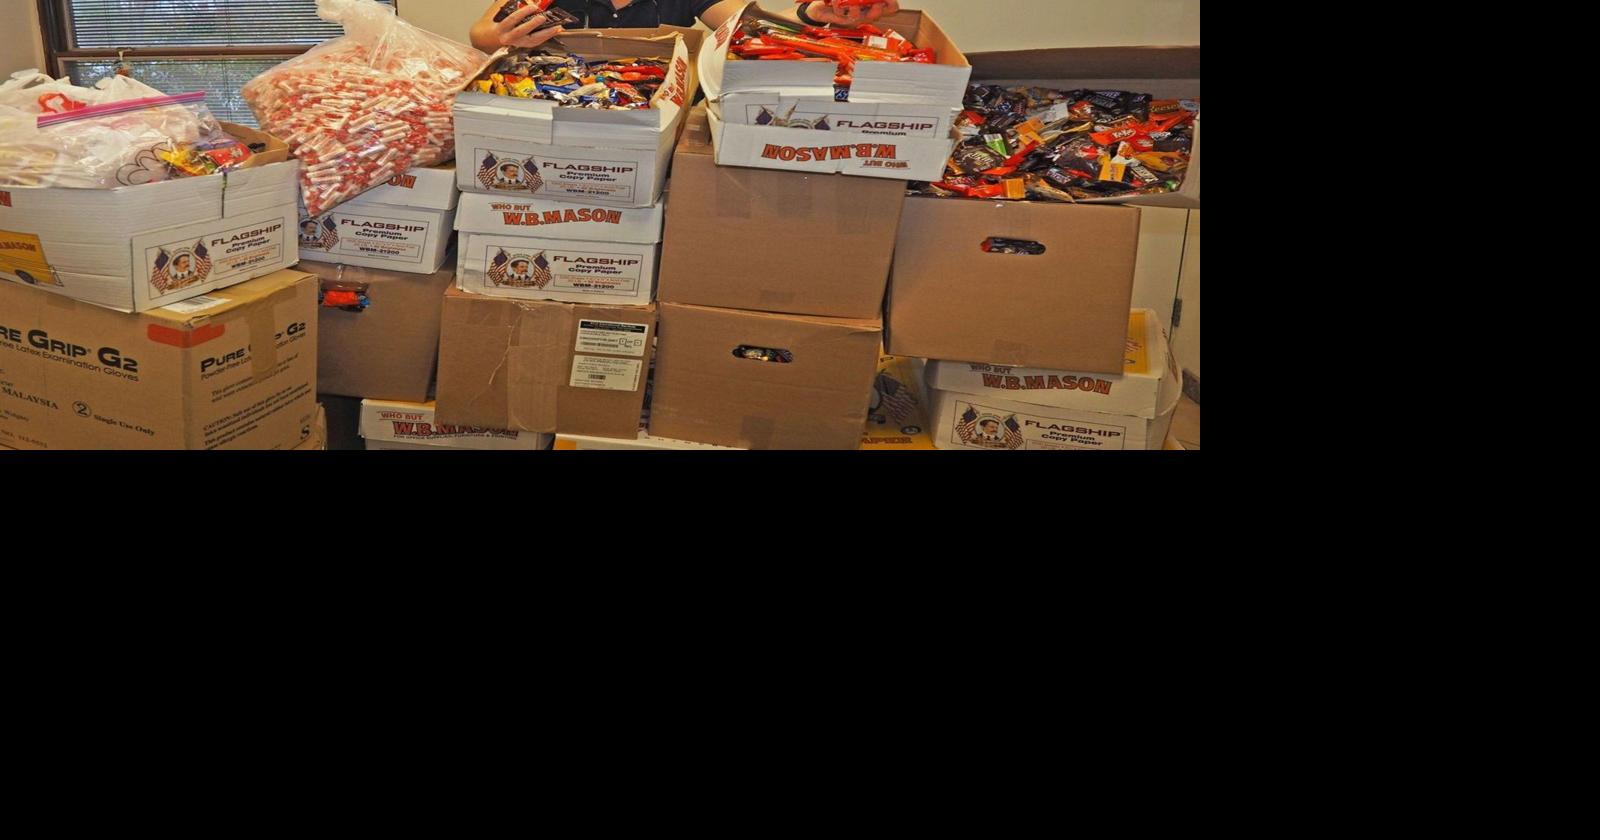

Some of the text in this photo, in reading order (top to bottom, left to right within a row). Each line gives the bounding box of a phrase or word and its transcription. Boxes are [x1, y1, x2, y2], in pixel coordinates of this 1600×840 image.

[836, 120, 934, 131] FLAGSHIP
[761, 143, 897, 162] W.B.MASON
[542, 161, 634, 173] FLAGSHIP
[559, 173, 617, 182] Copy Paper
[491, 203, 512, 211] WHO
[502, 208, 623, 226] W.B.MASON
[340, 218, 425, 233] FLAGSHIP
[362, 228, 402, 236] Premium
[211, 224, 282, 247] FLAGSHIP
[355, 231, 409, 241] Copy Paper
[226, 239, 271, 254] Copy Paper
[552, 255, 639, 266] FLAGSHIP
[575, 263, 616, 271] Premium
[568, 267, 593, 275] Copy
[287, 322, 306, 336] G2
[28, 329, 88, 358] GRIP
[97, 347, 139, 373] G2
[16, 345, 42, 358] Latex
[42, 351, 101, 373] Examination
[103, 367, 140, 383] Gloves
[201, 347, 246, 372] PURE
[993, 365, 1012, 374] BUT
[982, 373, 1113, 395] W.B.MASON
[1, 387, 59, 410] MALAYSIA
[119, 421, 133, 430] Use
[135, 425, 155, 436] Only
[300, 424, 311, 440] S
[1024, 419, 1122, 438] FLAGSHIP
[1041, 434, 1103, 446] Copy Paper
[1049, 431, 1095, 441] Premium
